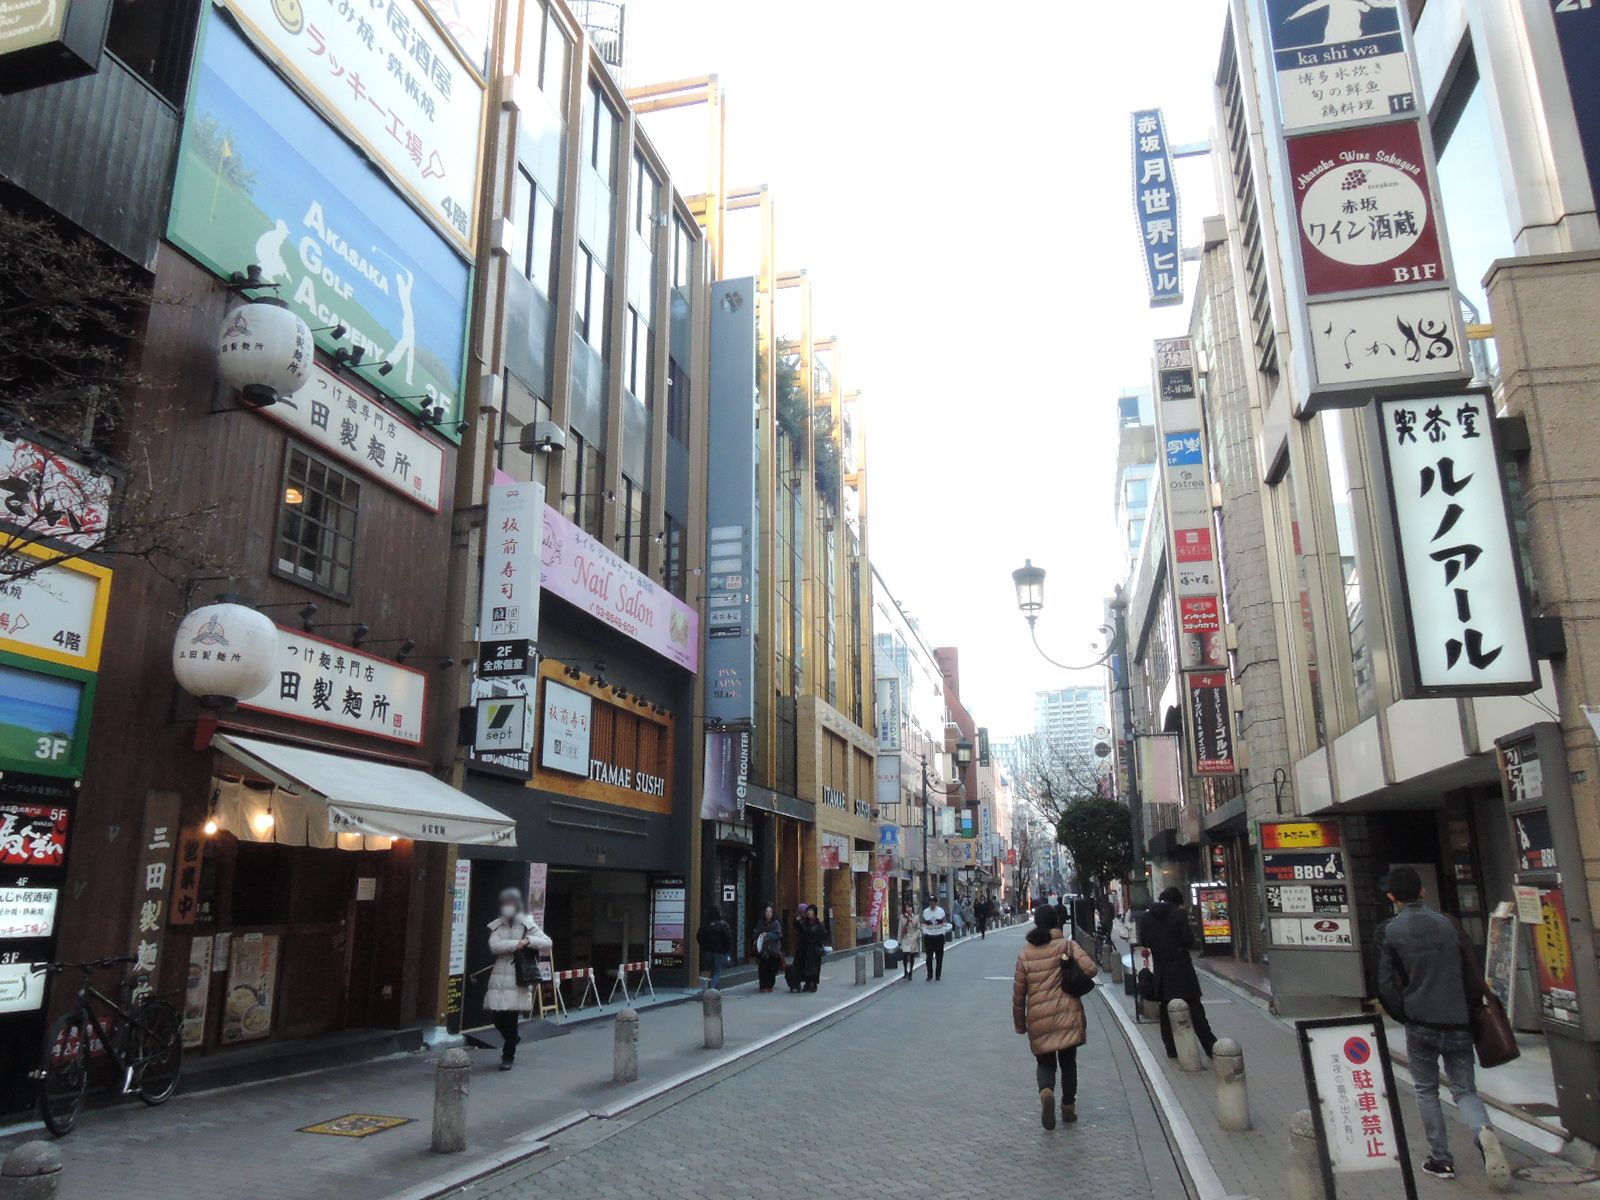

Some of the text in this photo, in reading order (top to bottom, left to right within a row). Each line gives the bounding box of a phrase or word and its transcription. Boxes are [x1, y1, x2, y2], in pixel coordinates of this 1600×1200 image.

[306, 22, 424, 168] ラッキー工場
[1311, 79, 1381, 101] 旬の鮮魚
[1392, 96, 1412, 110] 1F
[1320, 99, 1376, 118] 鶏料理
[440, 194, 468, 237] 4階
[1136, 116, 1177, 291] 赤坂月世界ビル
[1341, 196, 1380, 214] 赤坂
[1309, 210, 1418, 246] ワイン酒蔵
[302, 200, 389, 295] AKASAKA
[299, 235, 353, 300] GOLF
[1392, 263, 1437, 283] B1F
[293, 275, 384, 363] ACADEMY
[317, 377, 398, 439] つけ麺専門店
[1393, 402, 1481, 447] 喫茶室
[1170, 479, 1204, 489] Ostrea
[500, 517, 520, 600] 板前寿司
[1420, 456, 1504, 672] ルノアール
[571, 555, 614, 601] Nail
[615, 583, 654, 629] Salon
[52, 629, 81, 652] 4階
[496, 645, 513, 657] 2F
[287, 644, 375, 683] つけ麺専門店
[483, 658, 523, 671] 全席個室
[548, 703, 588, 732] 板前寿司
[34, 736, 68, 760] 3F
[486, 726, 513, 745] sept
[589, 759, 664, 797] ITAMAE SUSHI
[49, 808, 68, 821] 5F
[16, 876, 29, 887] 4F
[1294, 865, 1324, 880] BBC
[1, 952, 20, 964] 3F
[1351, 1068, 1387, 1158] 駐車禁止
